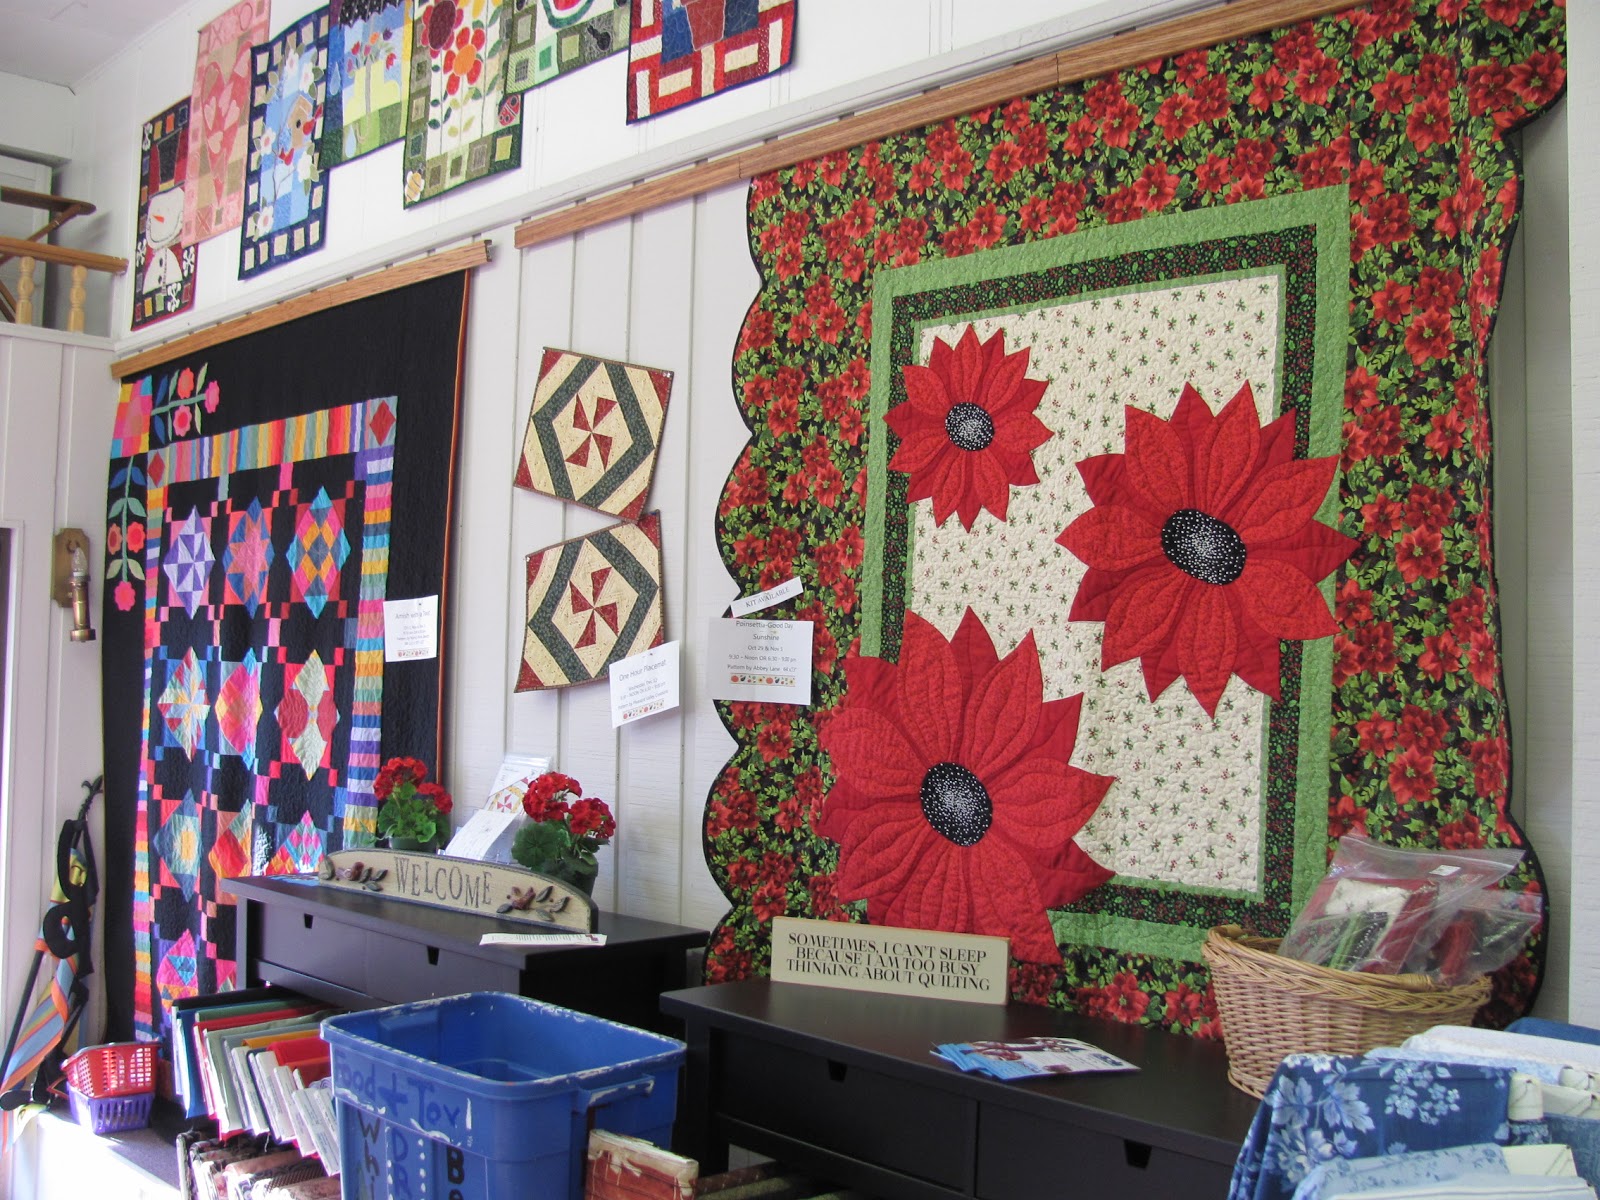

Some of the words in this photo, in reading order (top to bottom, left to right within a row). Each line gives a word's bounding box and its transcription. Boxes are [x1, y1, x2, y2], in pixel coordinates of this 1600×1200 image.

[745, 598, 757, 608] KIT
[758, 586, 790, 604] AVAILABLE
[630, 668, 643, 677] Hour
[643, 659, 666, 672] Placemat
[393, 856, 492, 908] WELCOME
[788, 932, 879, 954] SOMETIMES,
[883, 942, 888, 954] I
[892, 943, 936, 959] CAN'T
[939, 948, 987, 963] SLEEP
[796, 946, 862, 966] BECAUSE
[867, 953, 872, 966] I
[875, 954, 900, 970] AM
[902, 957, 935, 972] TOO
[939, 961, 980, 976] BUSY
[786, 958, 858, 978] THINKING
[862, 968, 915, 984] ABOUT
[918, 973, 990, 992] QUILTING
